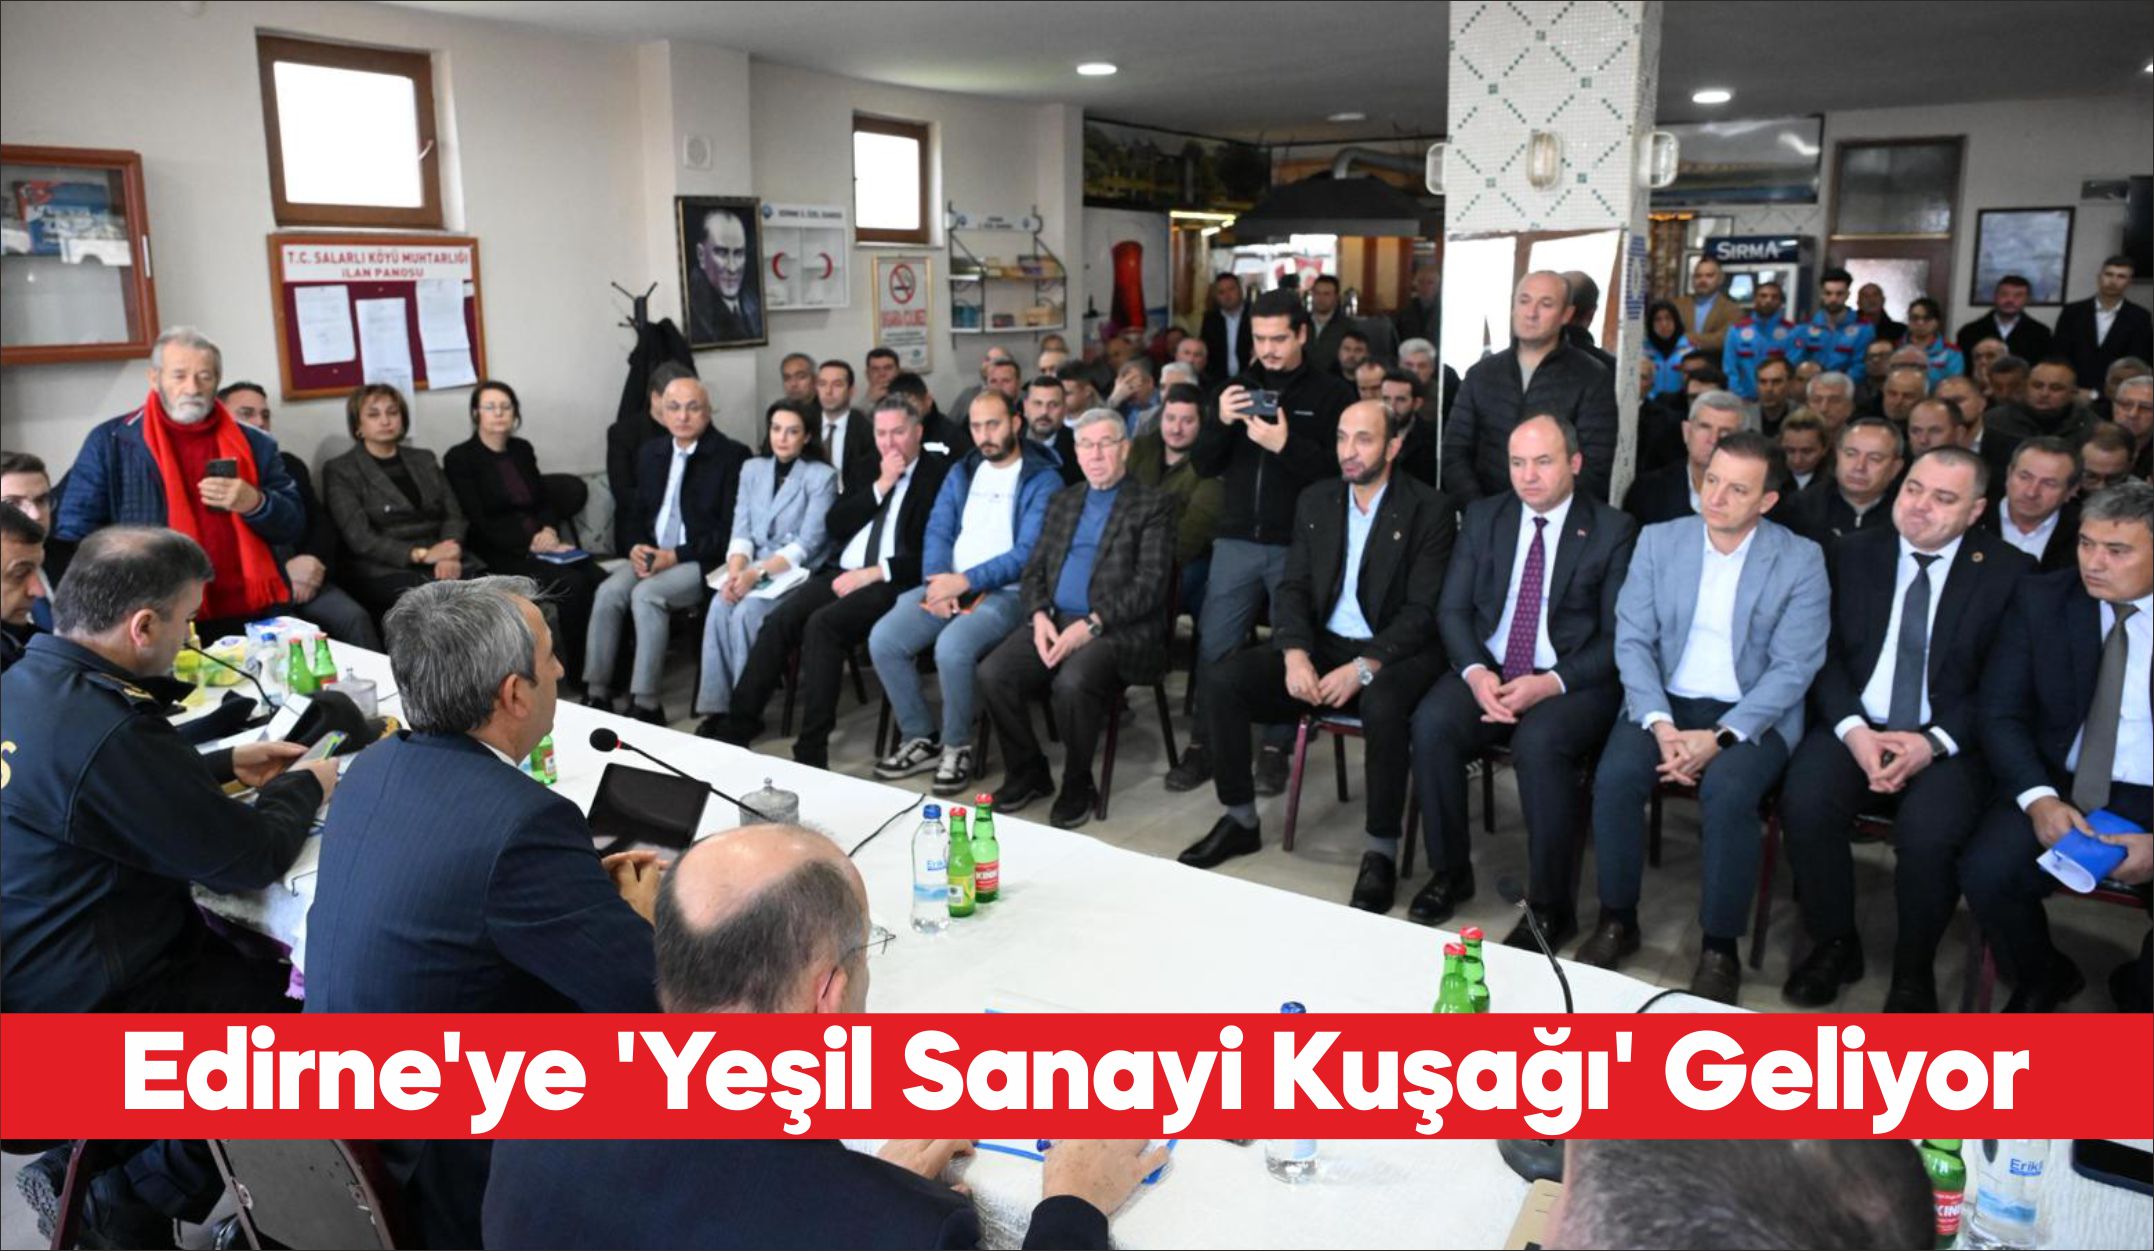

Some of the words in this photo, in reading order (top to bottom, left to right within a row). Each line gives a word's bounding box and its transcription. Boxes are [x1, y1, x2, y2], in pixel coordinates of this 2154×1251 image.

[287, 250, 312, 265] T.C.
[315, 250, 366, 265] SALARLI
[369, 249, 399, 265] KÖYÜ
[402, 249, 468, 265] MUHTARLIĞI
[375, 268, 424, 278] PANOSU
